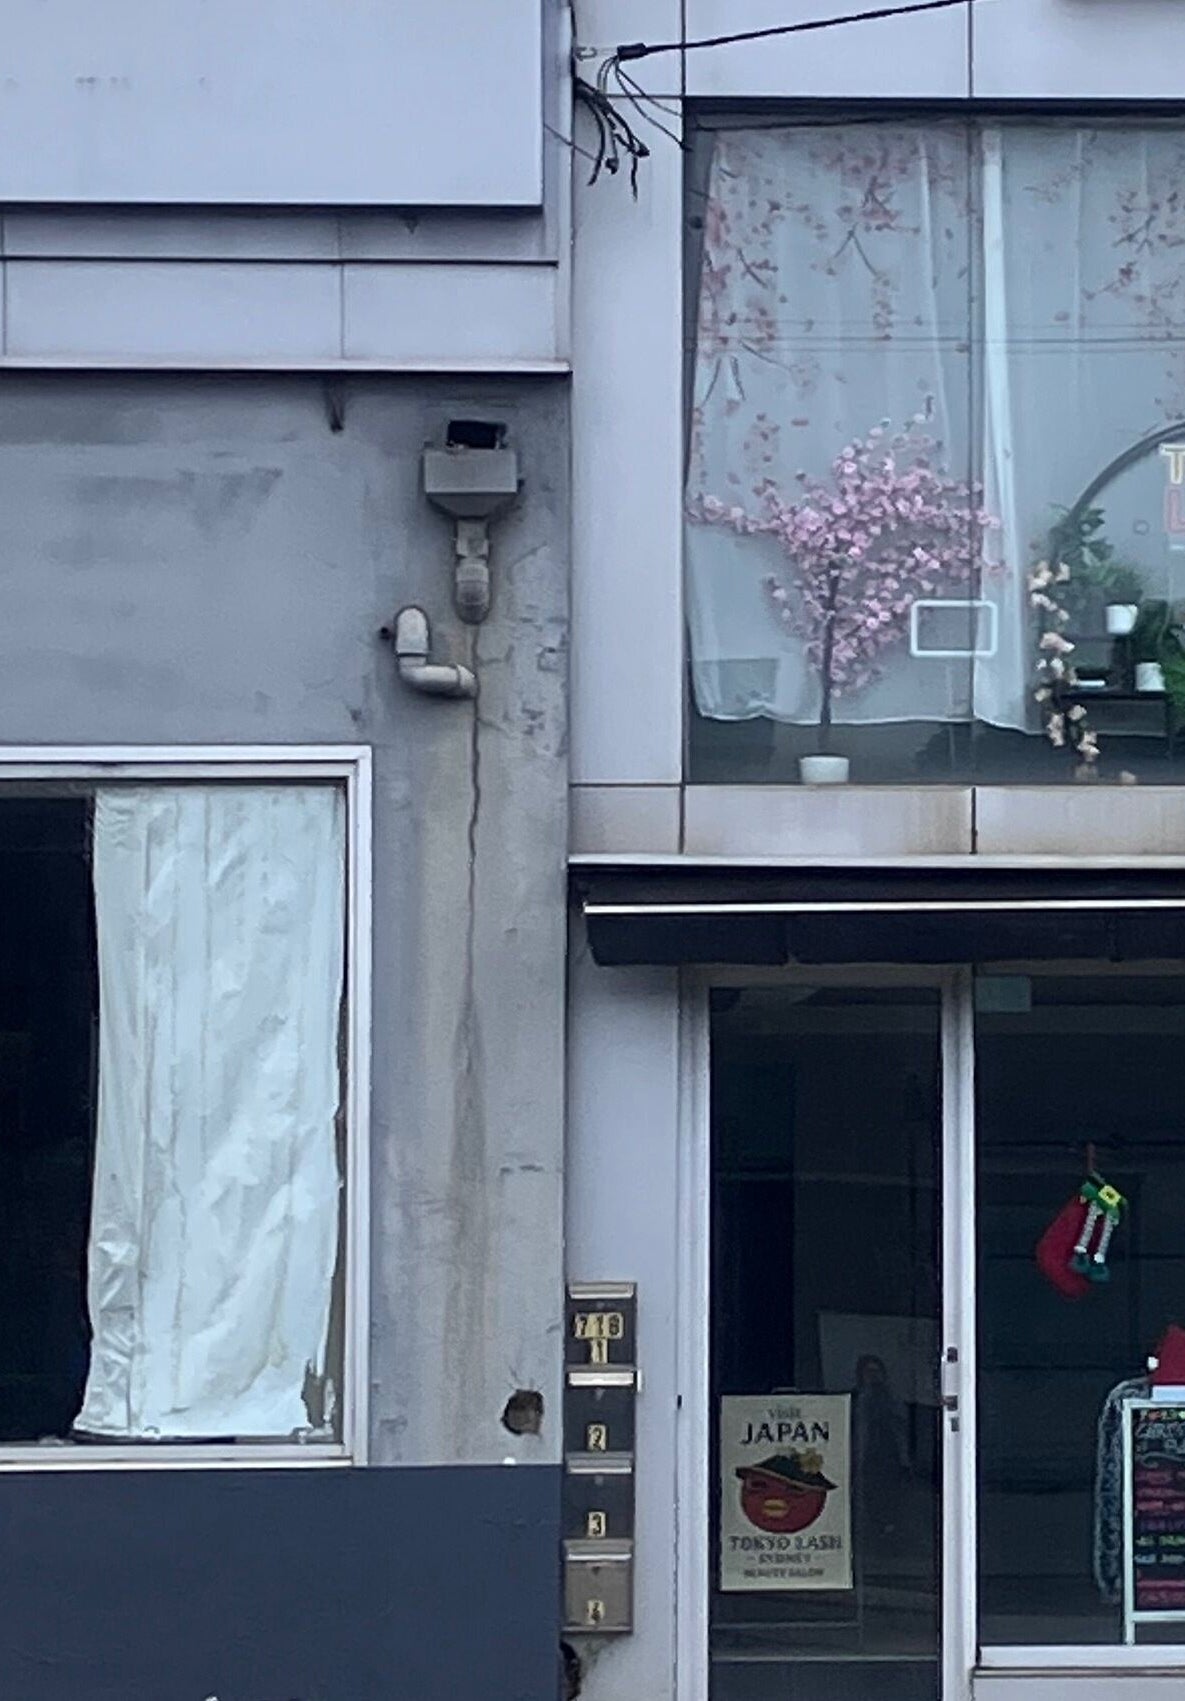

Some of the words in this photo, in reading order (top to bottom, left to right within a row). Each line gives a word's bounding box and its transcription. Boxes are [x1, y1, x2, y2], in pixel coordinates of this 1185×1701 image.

[590, 1425, 604, 1451] 2
[739, 1421, 830, 1445] JAPAN
[590, 1512, 604, 1536] 3
[728, 1534, 791, 1551] TOKYO
[794, 1534, 843, 1551] LASH
